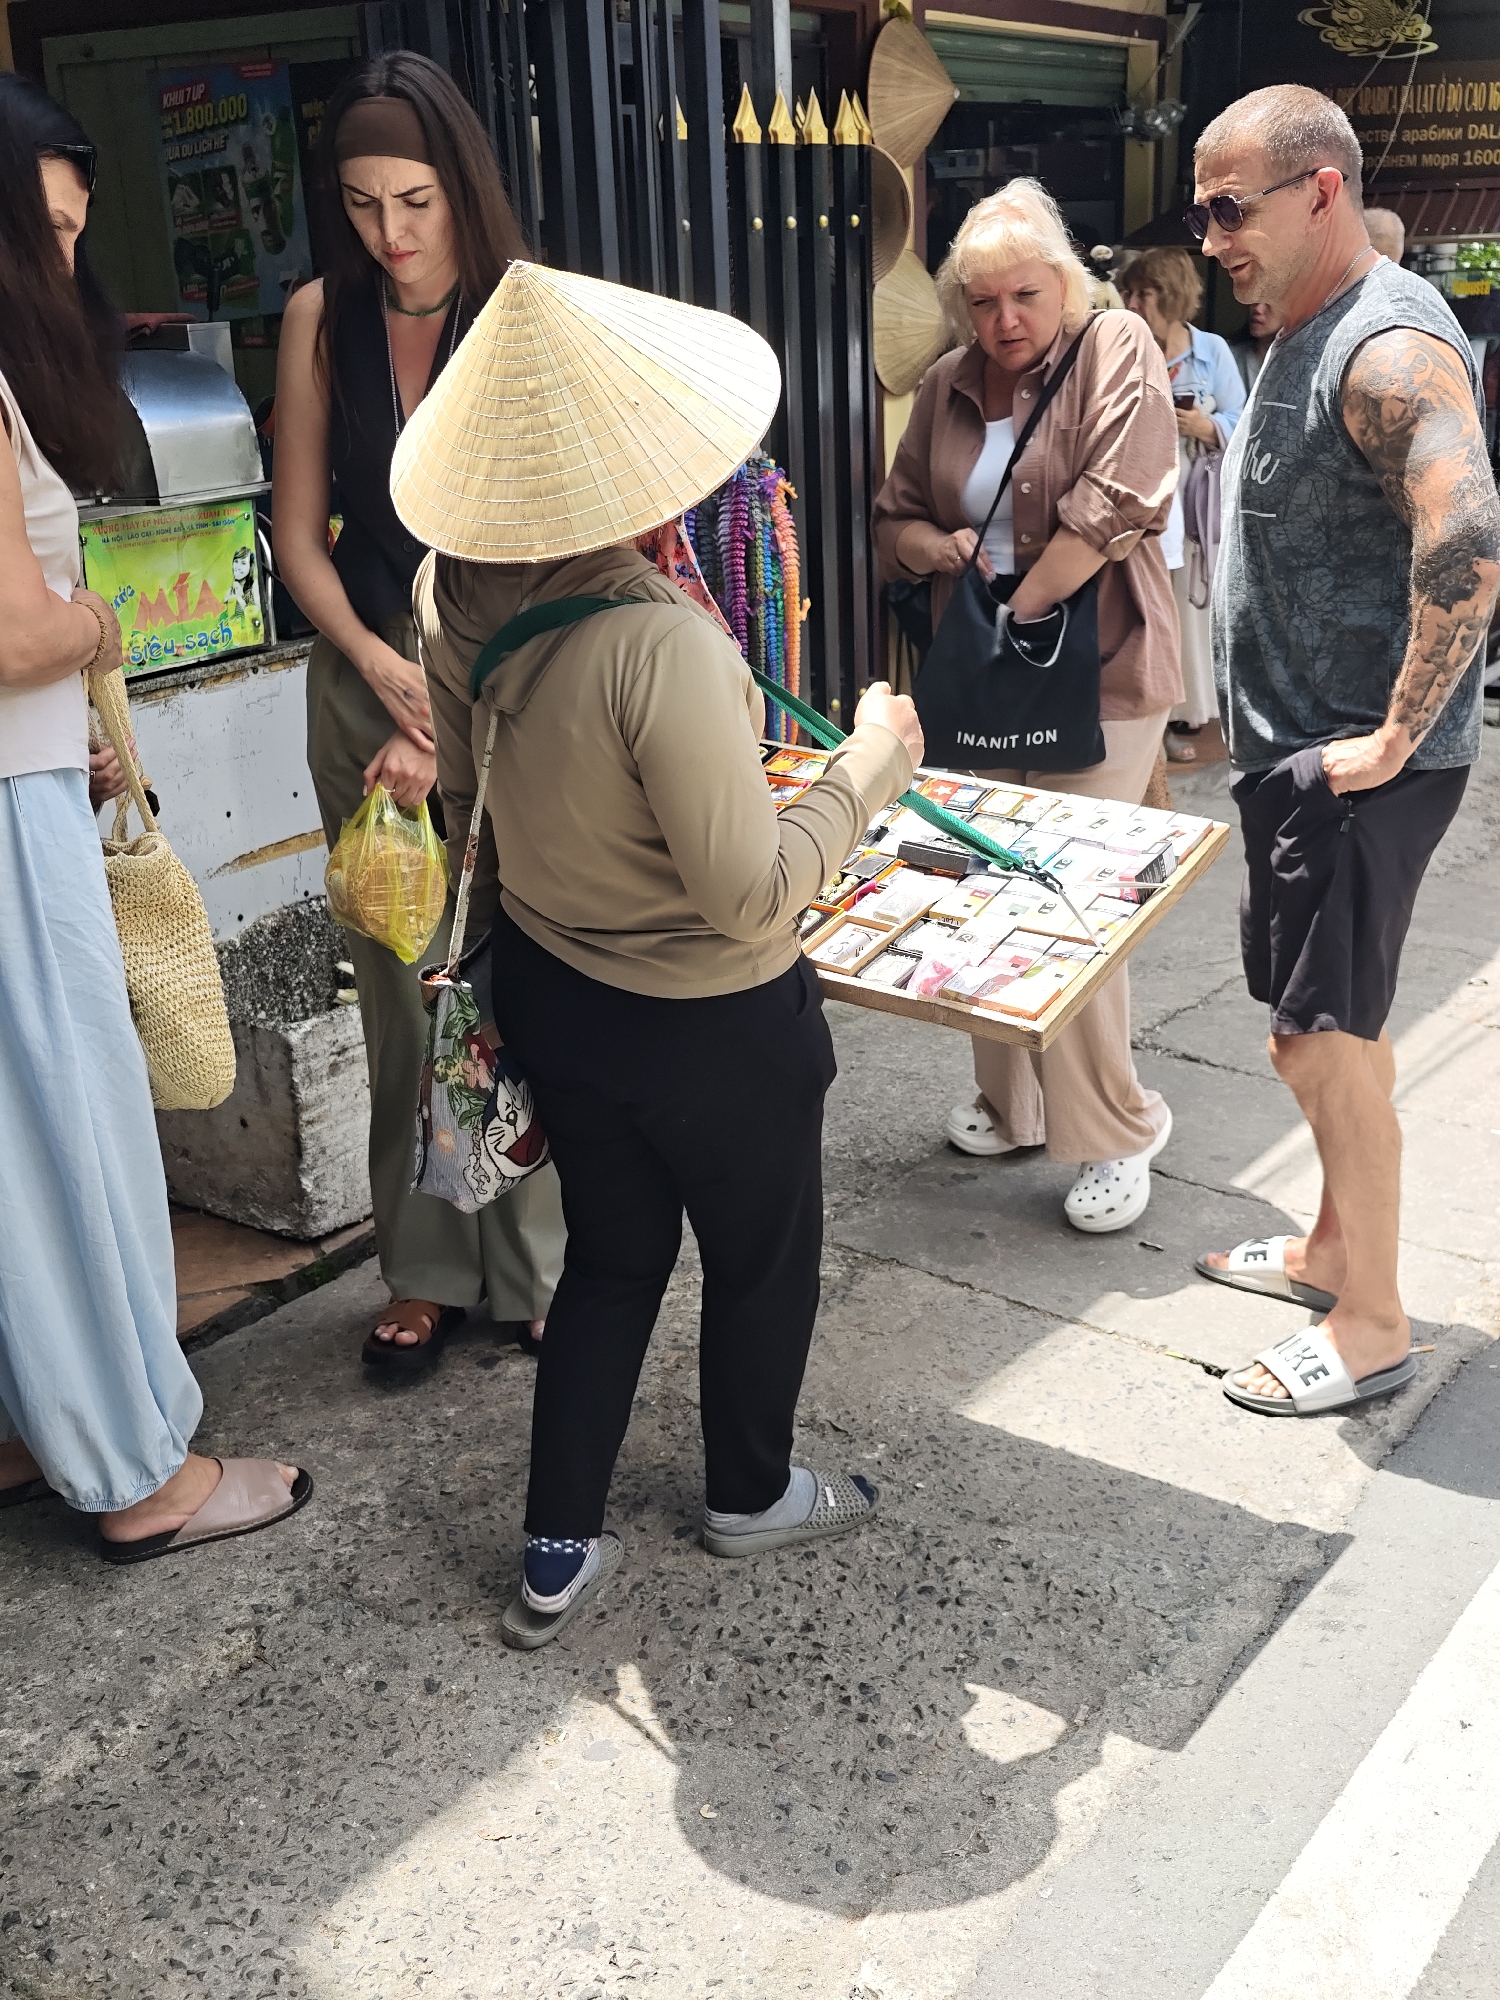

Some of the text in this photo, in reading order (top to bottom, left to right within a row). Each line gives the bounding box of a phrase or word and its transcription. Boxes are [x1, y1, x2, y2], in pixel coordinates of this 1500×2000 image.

[1464, 81, 1487, 112] CAO
[173, 92, 248, 135] 1.800.000
[1421, 153, 1459, 170] моря
[110, 583, 136, 612] ước
[131, 571, 228, 633] MÍA
[130, 619, 233, 663] siêu sạch
[956, 728, 1058, 750] INANIT ION
